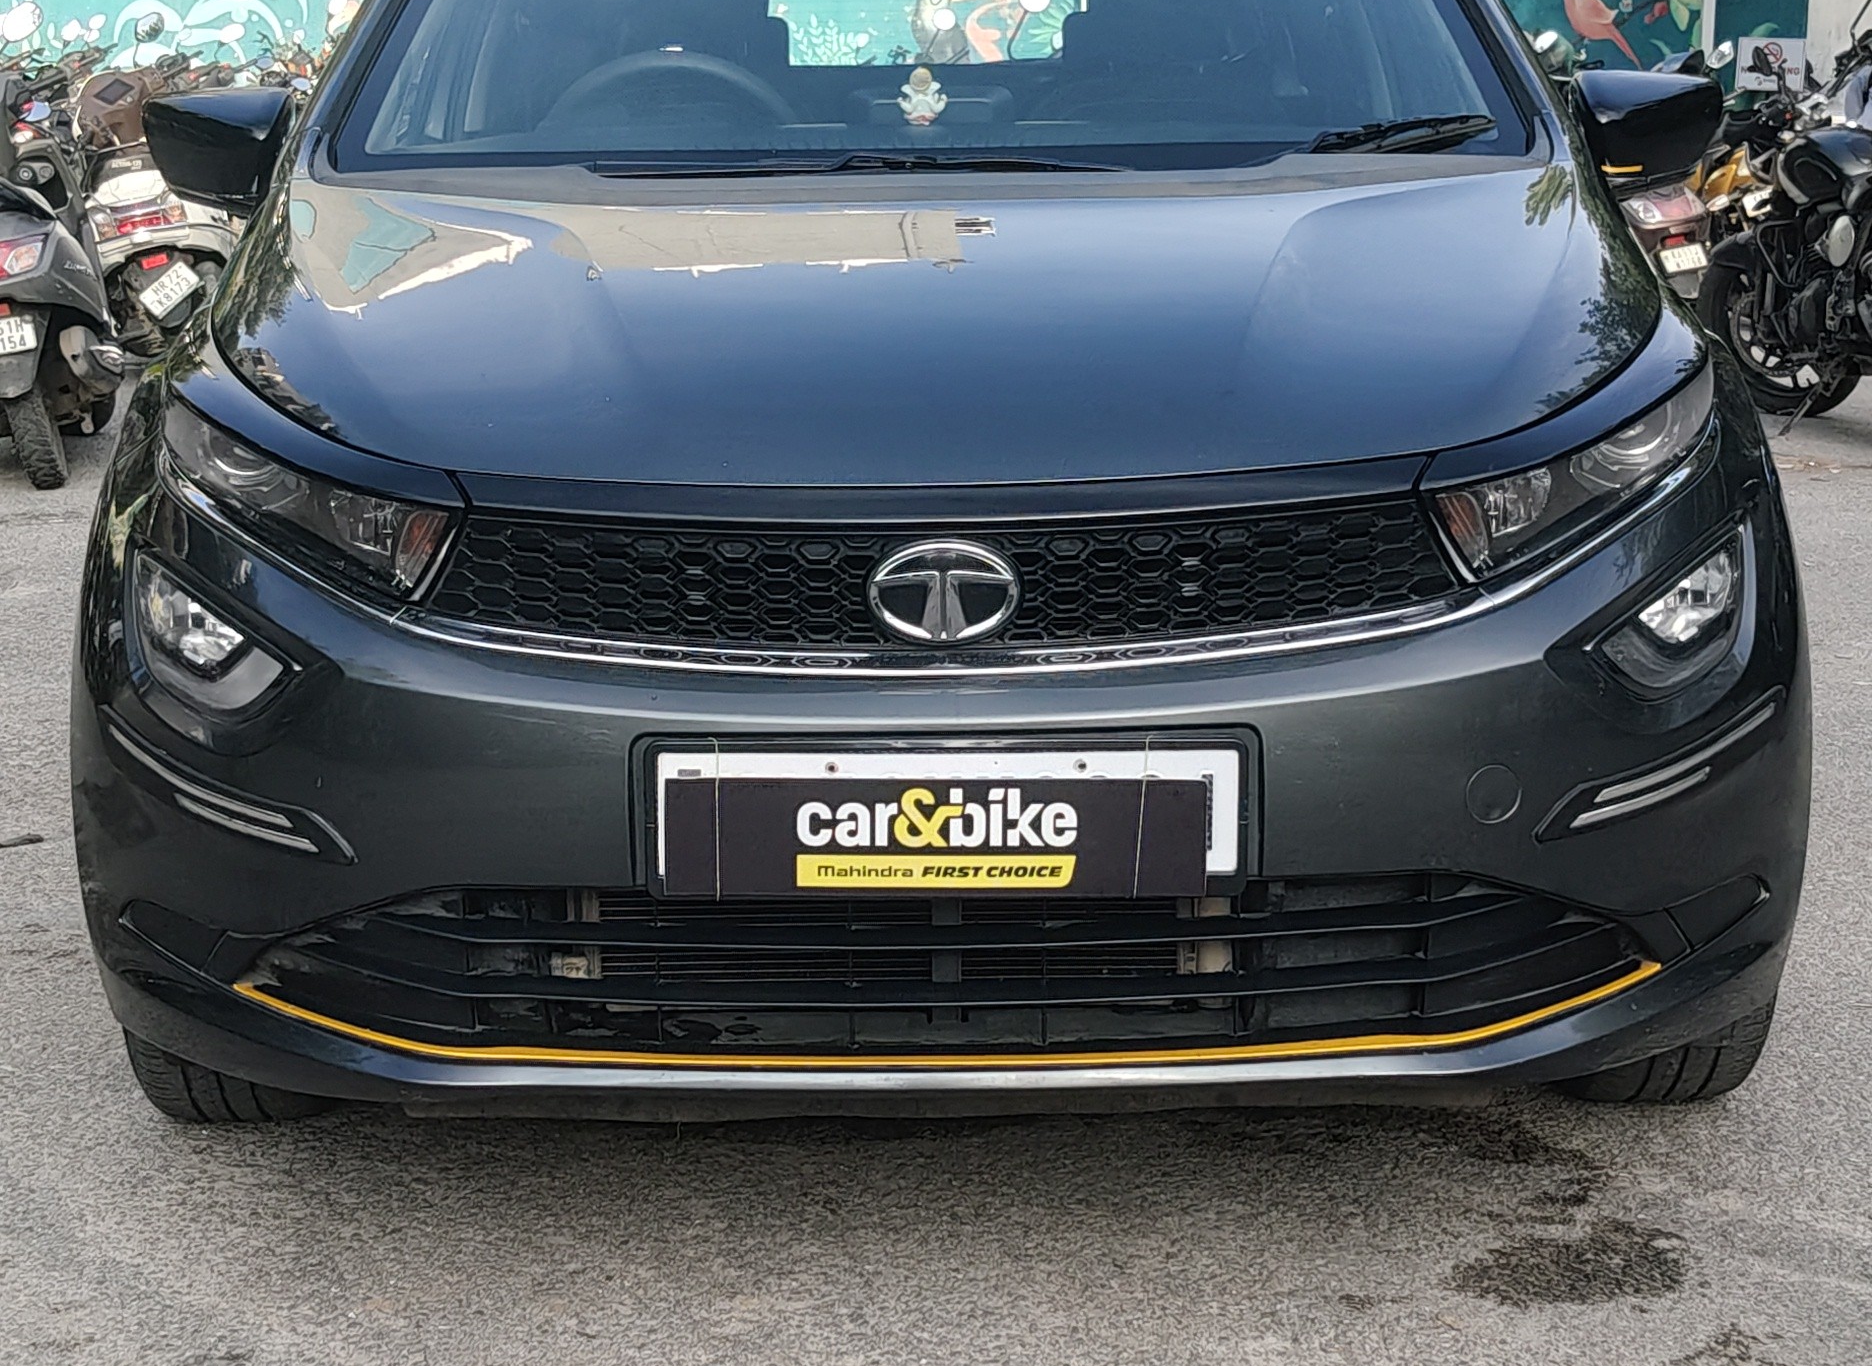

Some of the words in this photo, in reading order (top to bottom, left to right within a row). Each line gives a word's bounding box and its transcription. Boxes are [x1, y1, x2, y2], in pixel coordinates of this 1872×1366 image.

[151, 269, 182, 297] HR72
[156, 277, 191, 308] K8173
[796, 787, 1078, 848] car&bike
[816, 864, 914, 878] Mahindra
[921, 865, 984, 879] FIRST
[985, 865, 1064, 878] CHOICE
